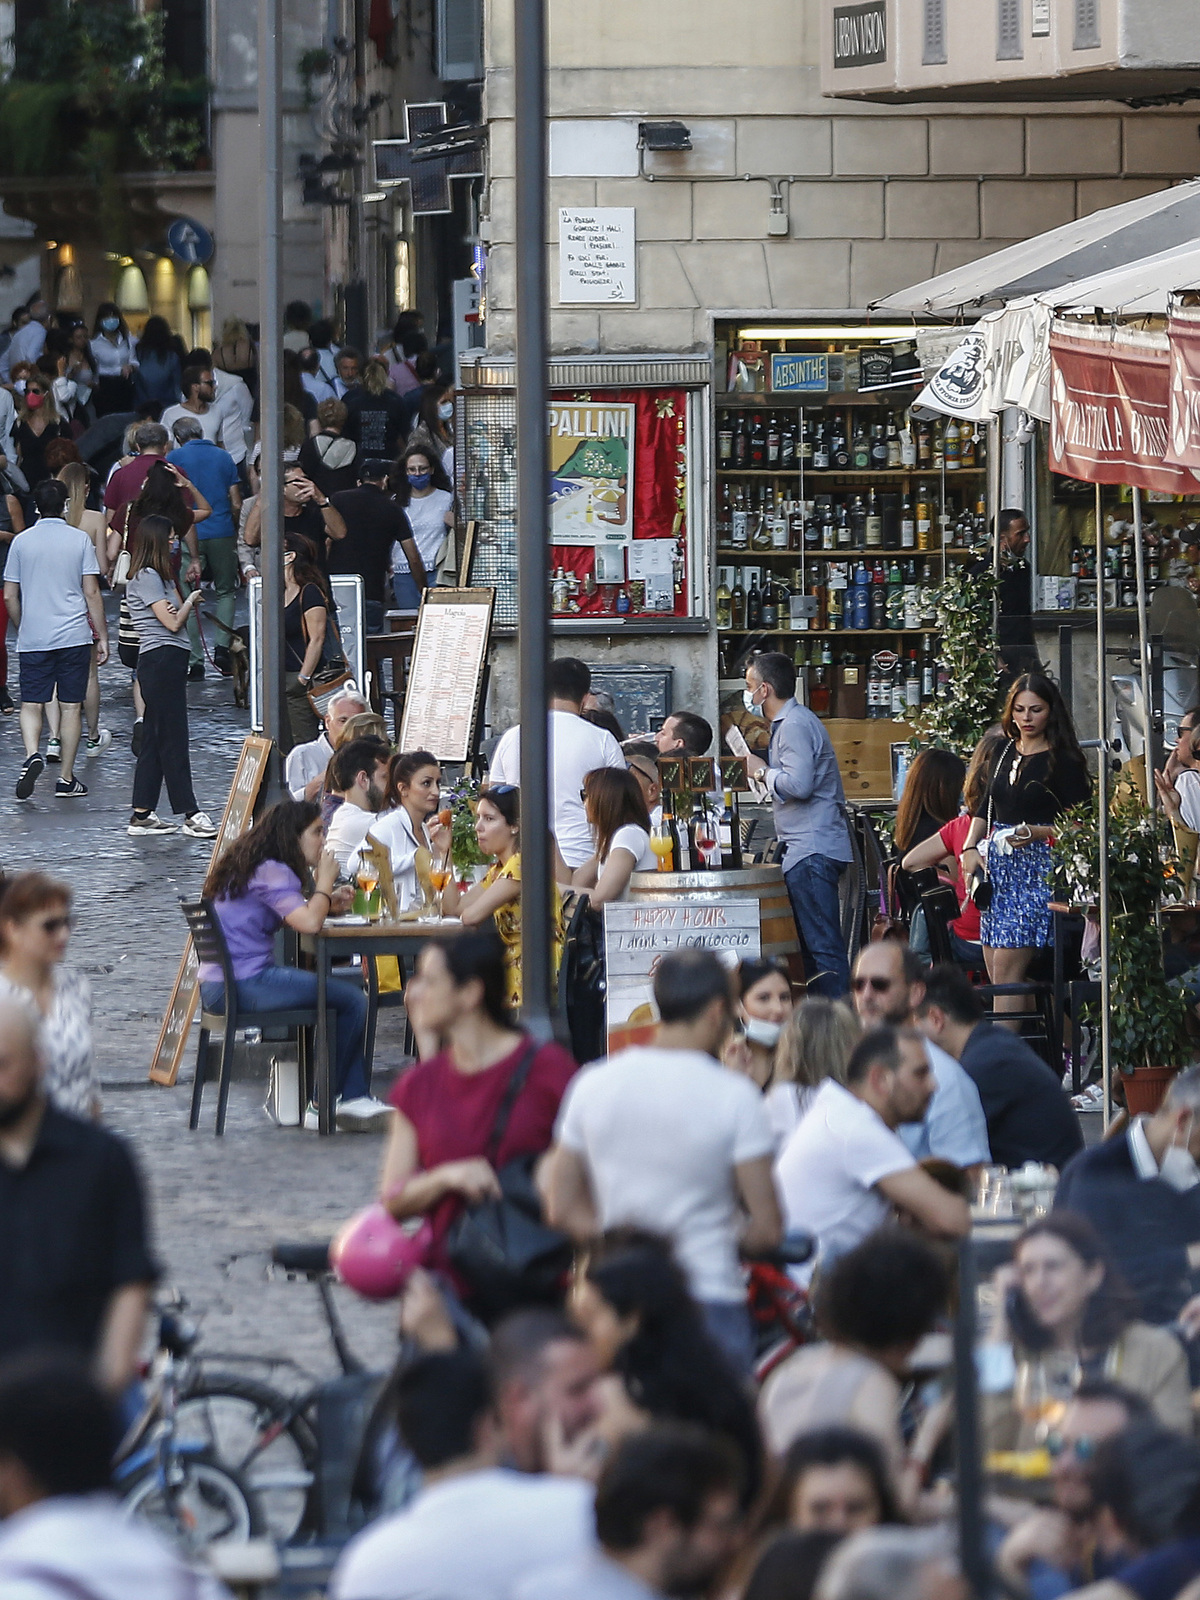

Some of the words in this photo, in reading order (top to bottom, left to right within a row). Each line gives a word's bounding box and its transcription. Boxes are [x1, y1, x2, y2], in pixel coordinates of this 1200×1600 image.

[775, 356, 825, 388] ABSINTHE
[939, 387, 959, 403] STORIA
[546, 409, 627, 437] PALLINI
[634, 907, 677, 928] HAPPY
[683, 907, 728, 928] HOUR
[628, 932, 659, 950] drink
[685, 931, 751, 949] cartoccio
